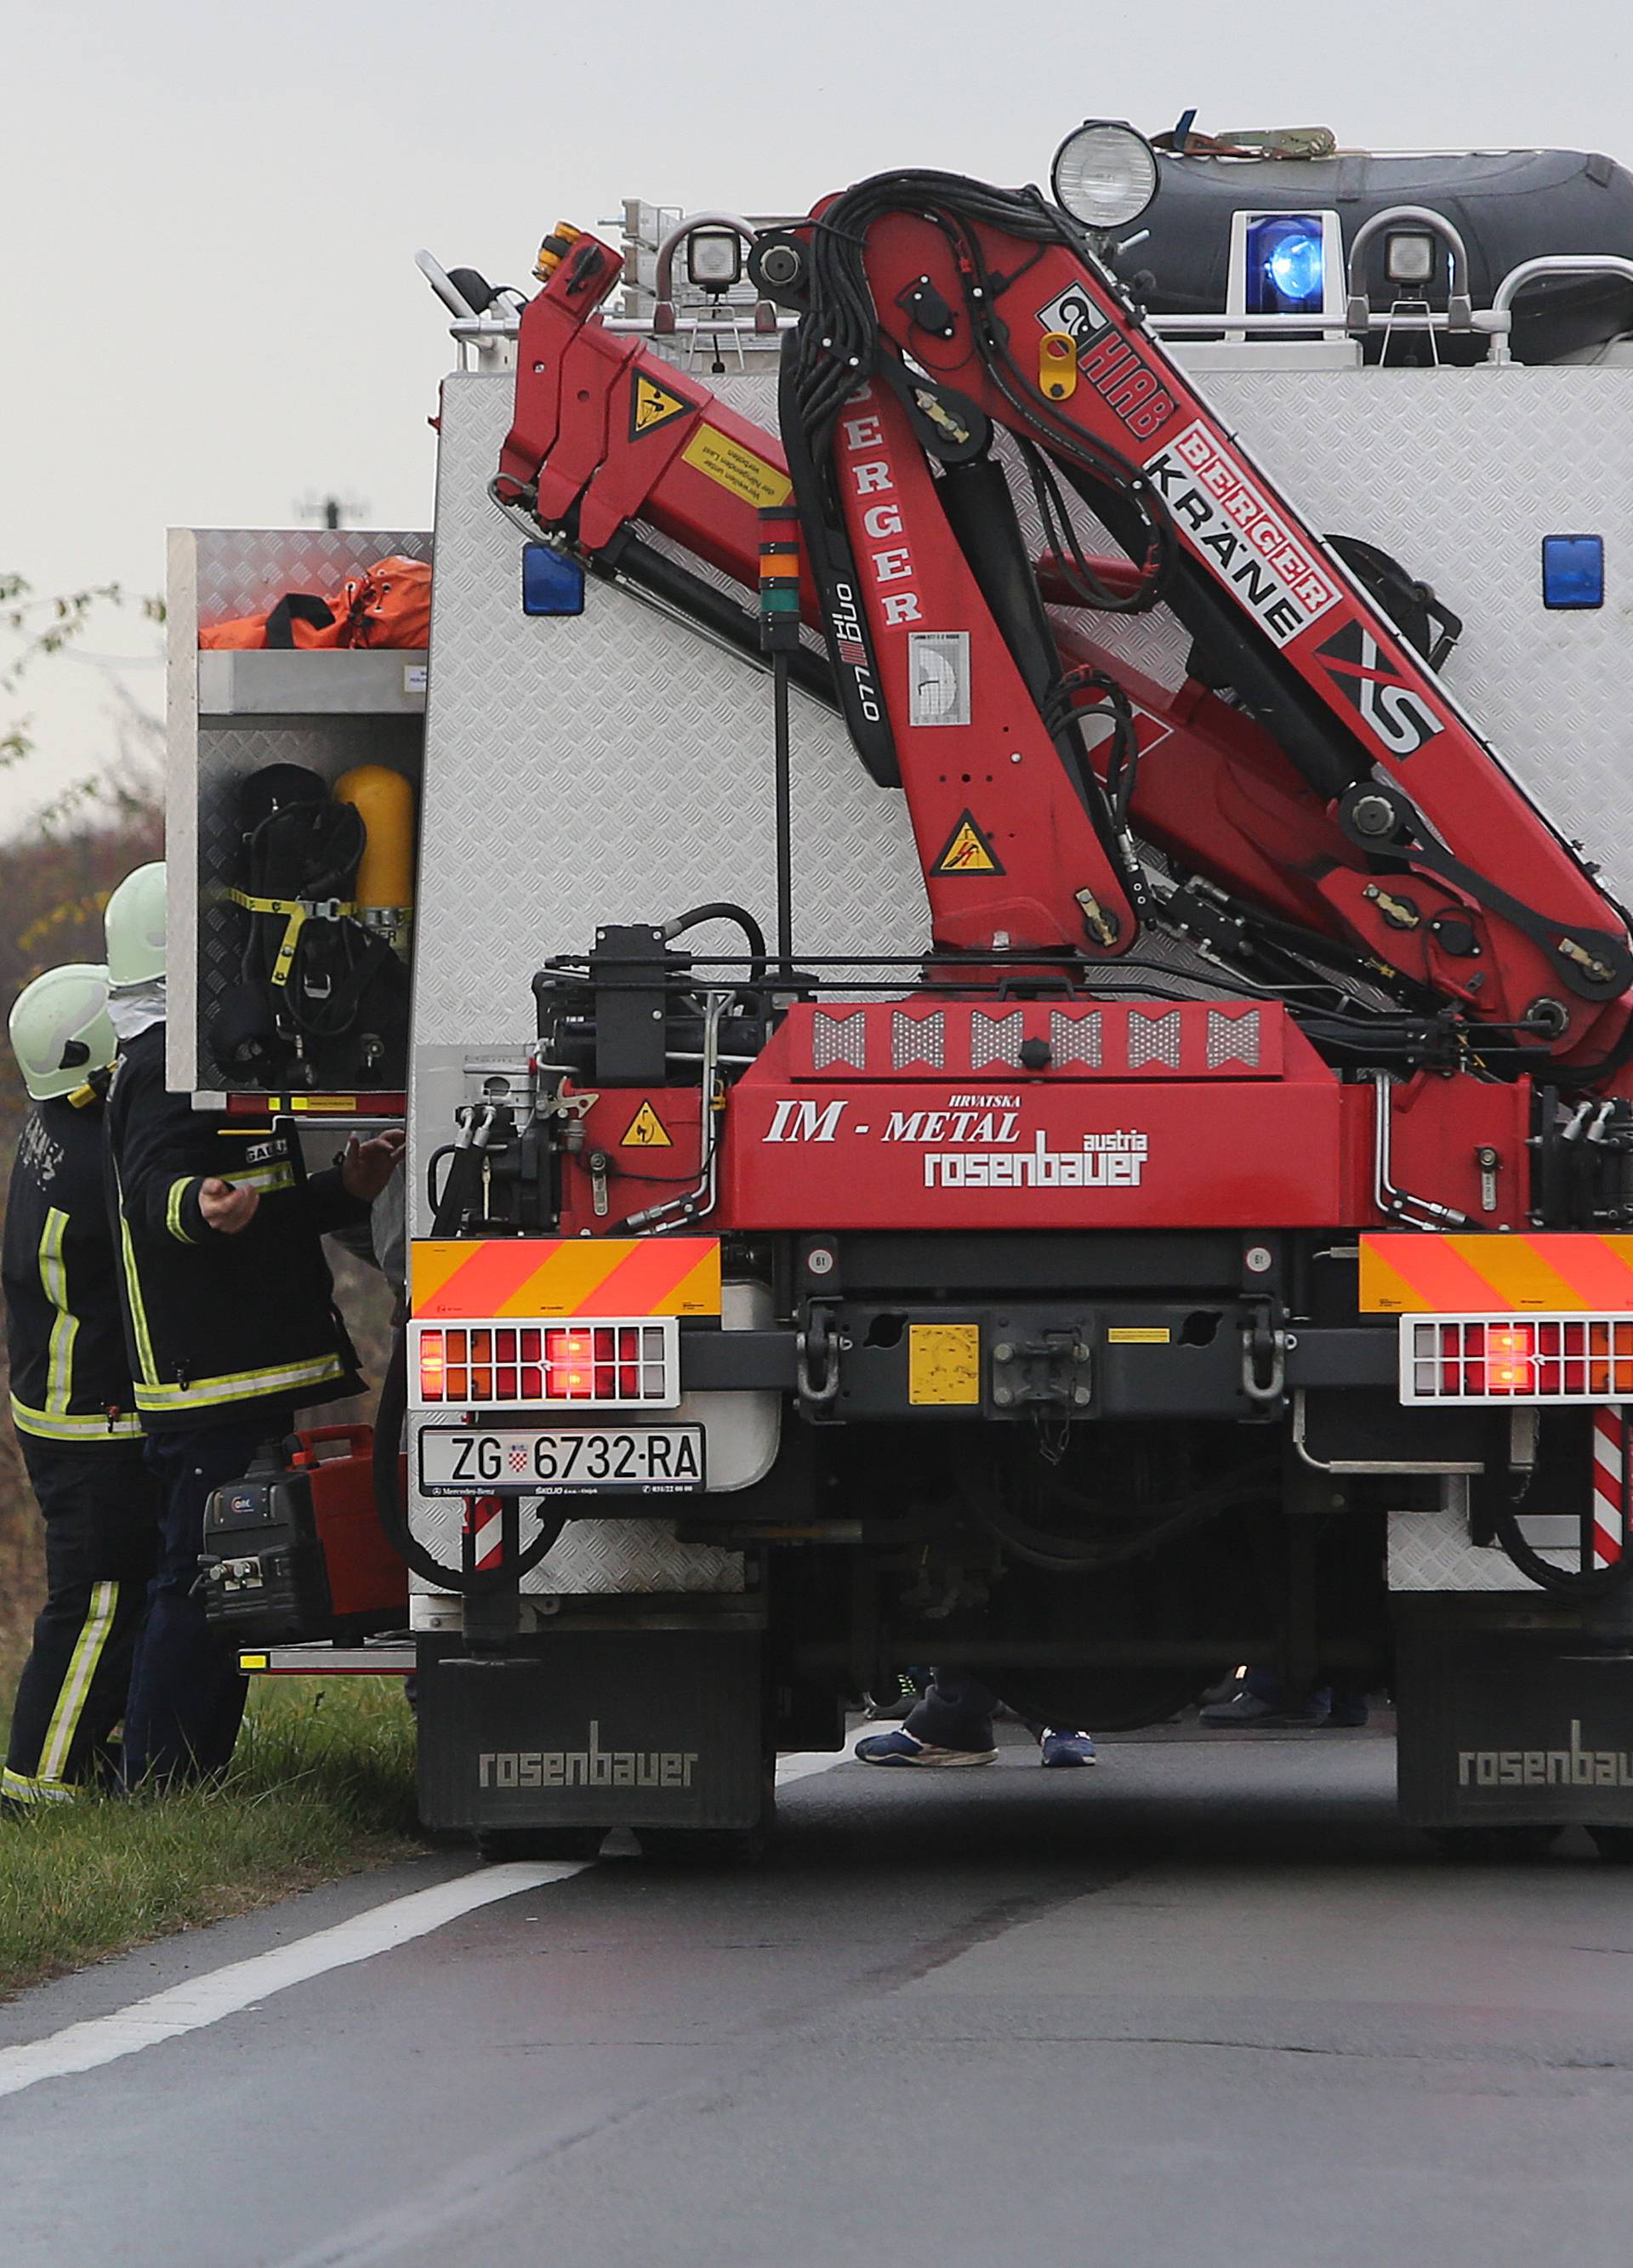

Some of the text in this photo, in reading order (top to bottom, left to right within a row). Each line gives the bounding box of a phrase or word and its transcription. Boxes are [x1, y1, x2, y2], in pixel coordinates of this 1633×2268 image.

[1077, 330, 1175, 439] HIAB
[1145, 453, 1305, 639] KRÄNE
[1177, 431, 1331, 612] BERGER
[855, 666, 880, 722] 077
[762, 1100, 849, 1142] IM
[880, 1111, 1021, 1142] METAL
[947, 1094, 1021, 1108] HRVATSKA
[924, 1129, 1148, 1187] rosenbauer
[1083, 1129, 1148, 1151] austria
[451, 1436, 502, 1481] ZG
[442, 1487, 495, 1496] Mercedes-Benz
[479, 1719, 700, 1788] rosenbauer
